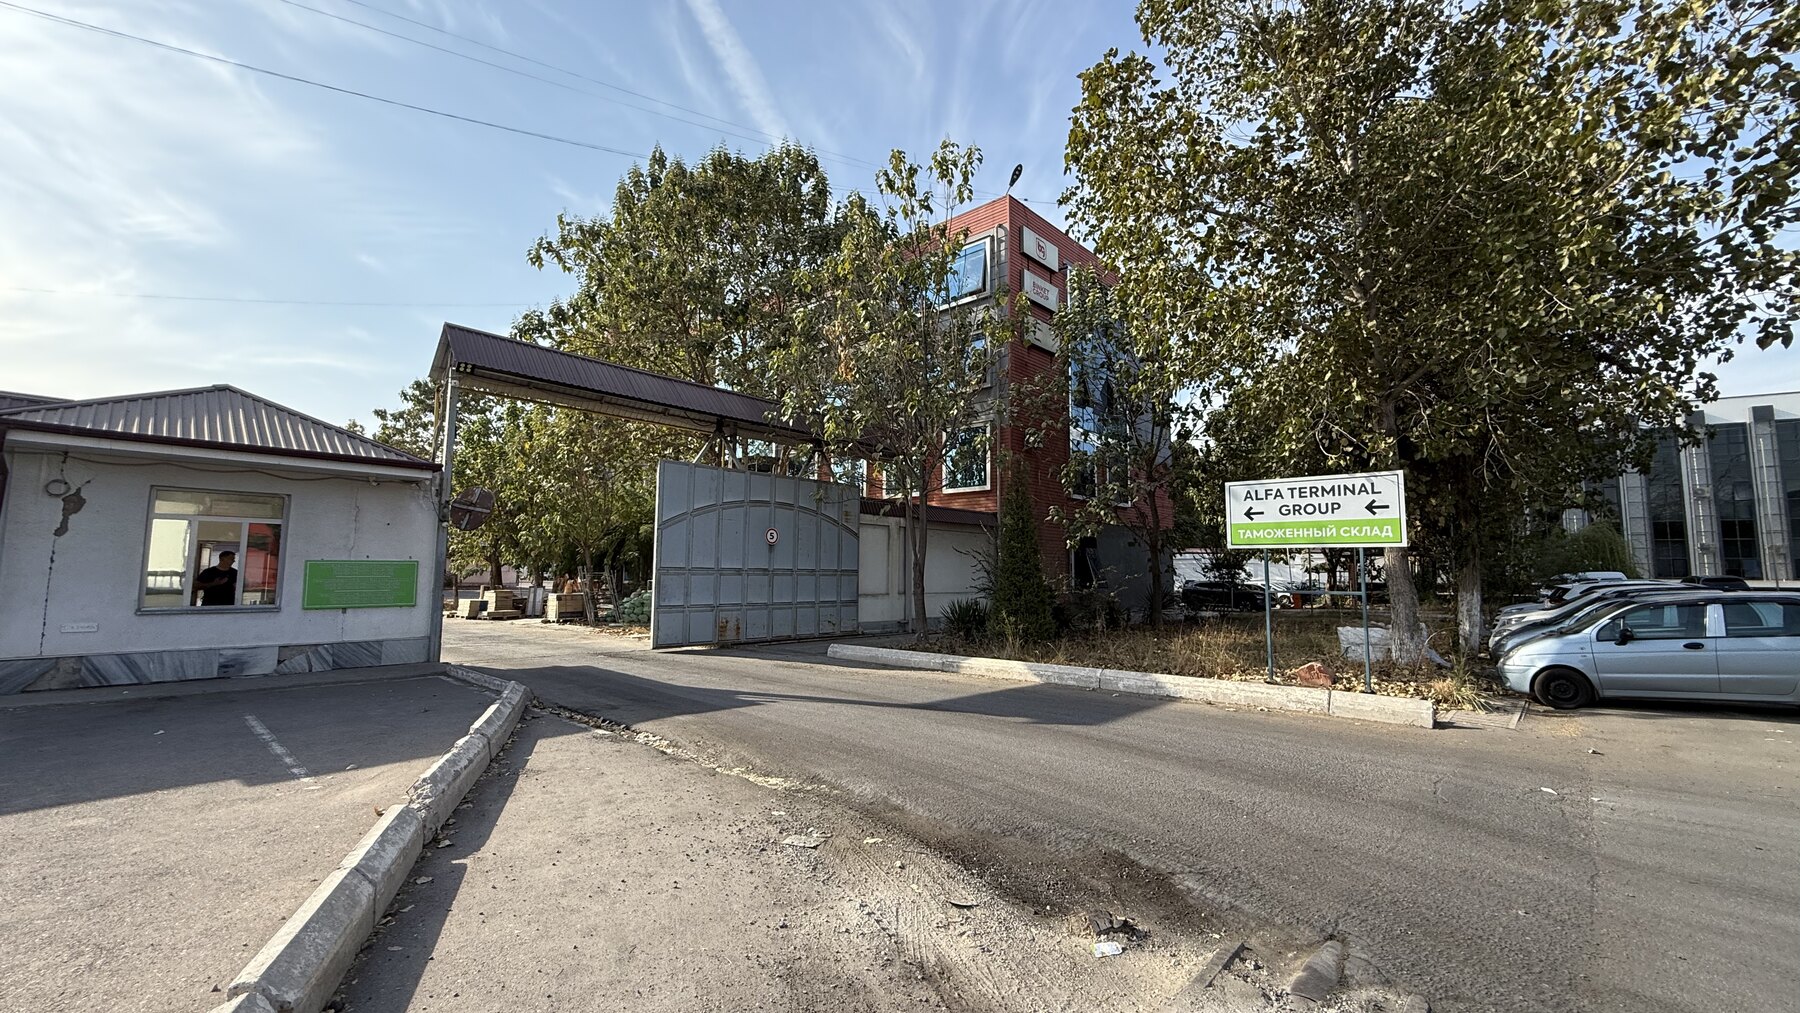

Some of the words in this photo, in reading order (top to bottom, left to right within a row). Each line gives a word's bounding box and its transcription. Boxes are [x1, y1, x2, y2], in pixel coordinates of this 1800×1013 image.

[1032, 288, 1050, 301] GROUP
[1243, 488, 1284, 502] ALFA
[1287, 482, 1382, 499] TERMINAL
[1278, 502, 1342, 516] GROUP
[769, 532, 775, 540] 5
[1237, 525, 1337, 539] ТАМОЖЕННЫЙ
[1340, 525, 1393, 538] СКЛАД
